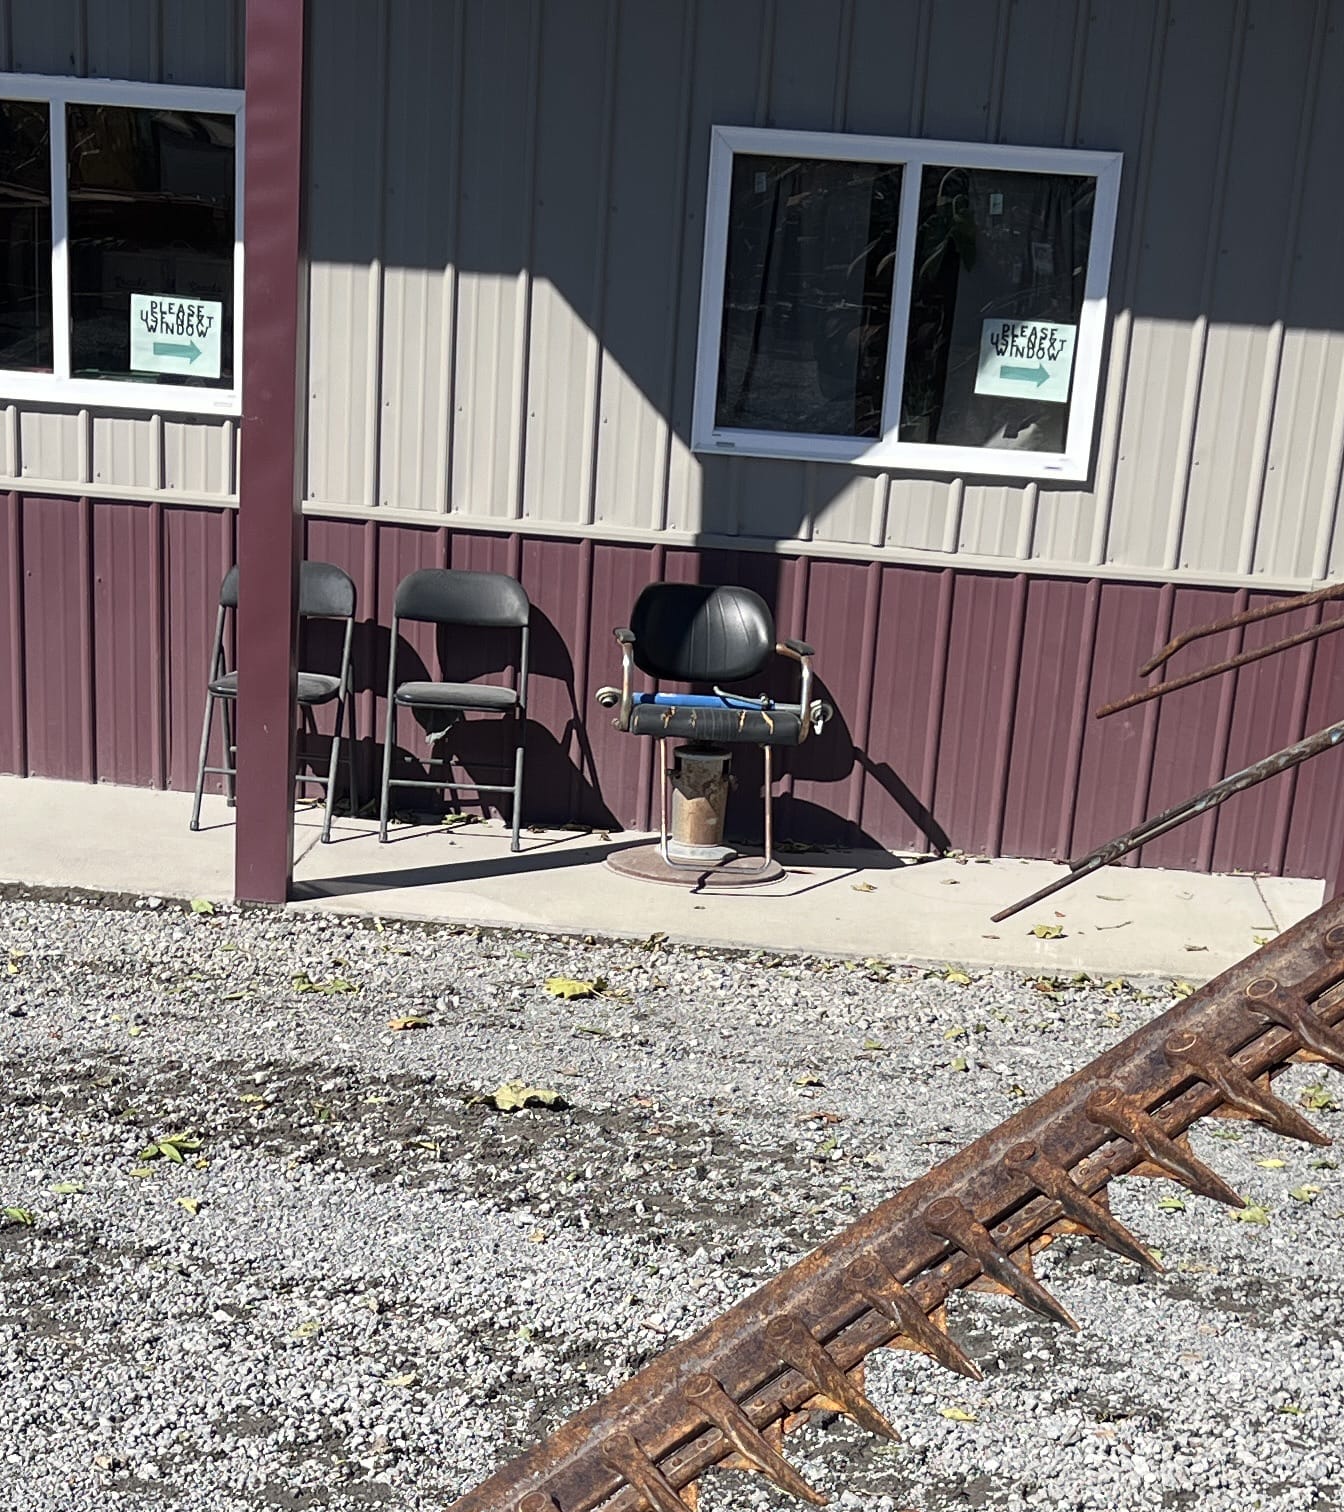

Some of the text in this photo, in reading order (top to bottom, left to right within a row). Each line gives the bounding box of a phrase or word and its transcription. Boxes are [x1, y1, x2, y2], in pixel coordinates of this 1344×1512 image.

[151, 301, 204, 317] PLEASE
[141, 310, 214, 328] USE NEXT
[146, 320, 208, 338] WINDOW
[1002, 324, 1058, 340] PLEASE
[990, 333, 1067, 351] USE NEXT
[996, 343, 1060, 361] WINDOW
